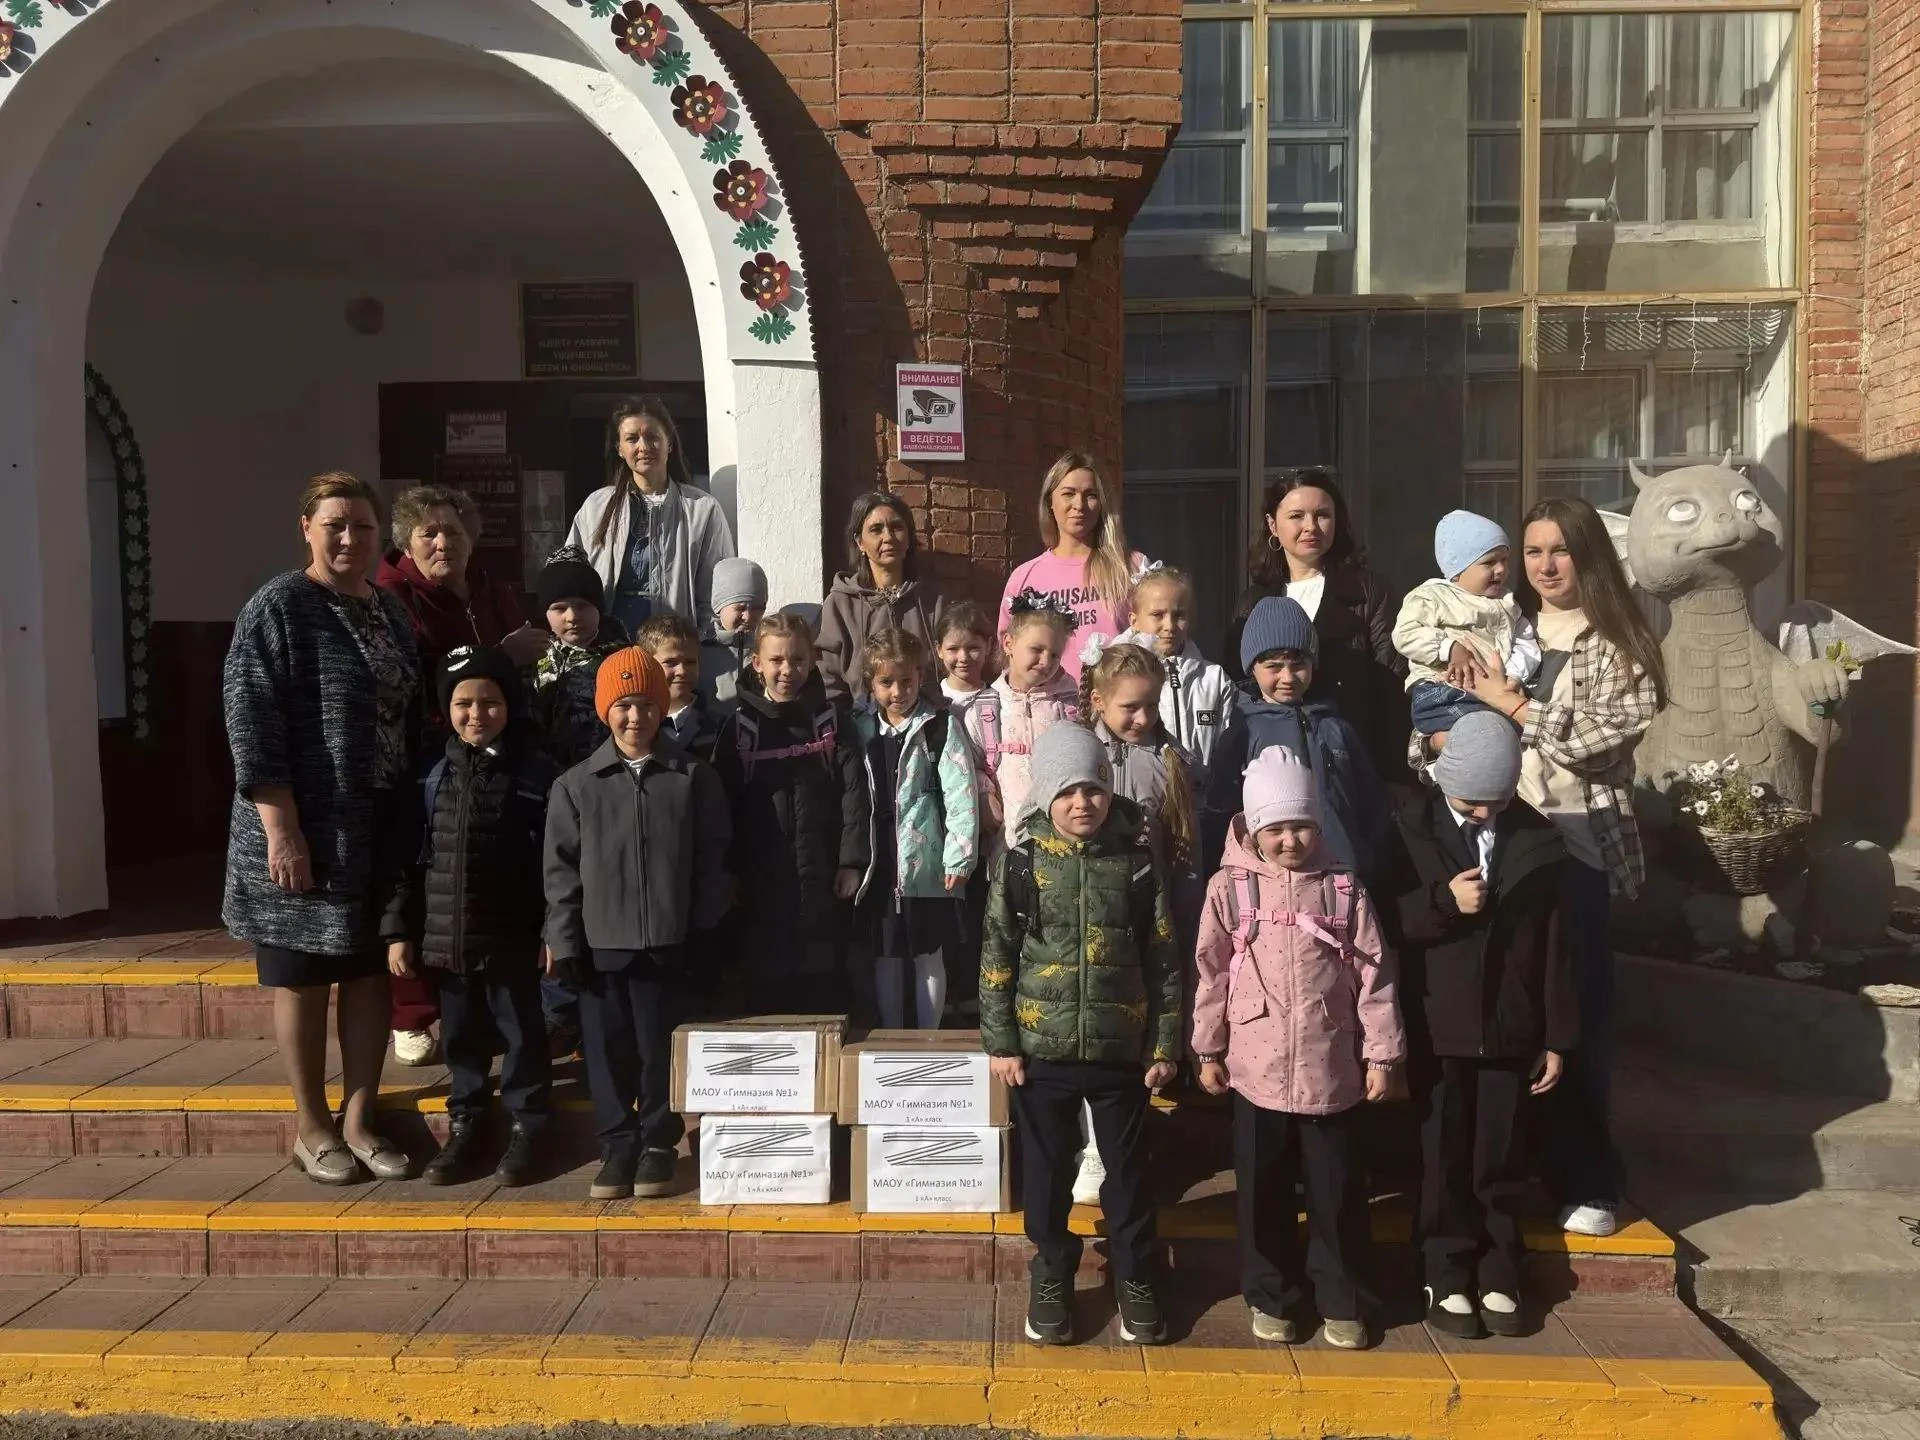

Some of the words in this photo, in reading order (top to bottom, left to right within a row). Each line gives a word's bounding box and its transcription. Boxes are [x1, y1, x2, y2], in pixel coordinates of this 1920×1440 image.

[901, 373, 960, 385] ВНИМАНИЕ!
[1050, 586, 1101, 605] OUSAN
[691, 1088, 721, 1097] МАОУ
[723, 1088, 774, 1097] «Гимназия
[775, 1088, 798, 1097] №1»
[864, 1100, 894, 1109] МАОУ
[896, 1100, 948, 1109] «Гимназия
[950, 1100, 973, 1109] №1»
[706, 1171, 735, 1180] МАОУ
[737, 1170, 789, 1180] «Гимназия
[791, 1169, 814, 1179] №1»
[873, 1179, 902, 1188] МАОУ
[905, 1179, 957, 1188] «Гимназия
[959, 1179, 983, 1188] №1»
